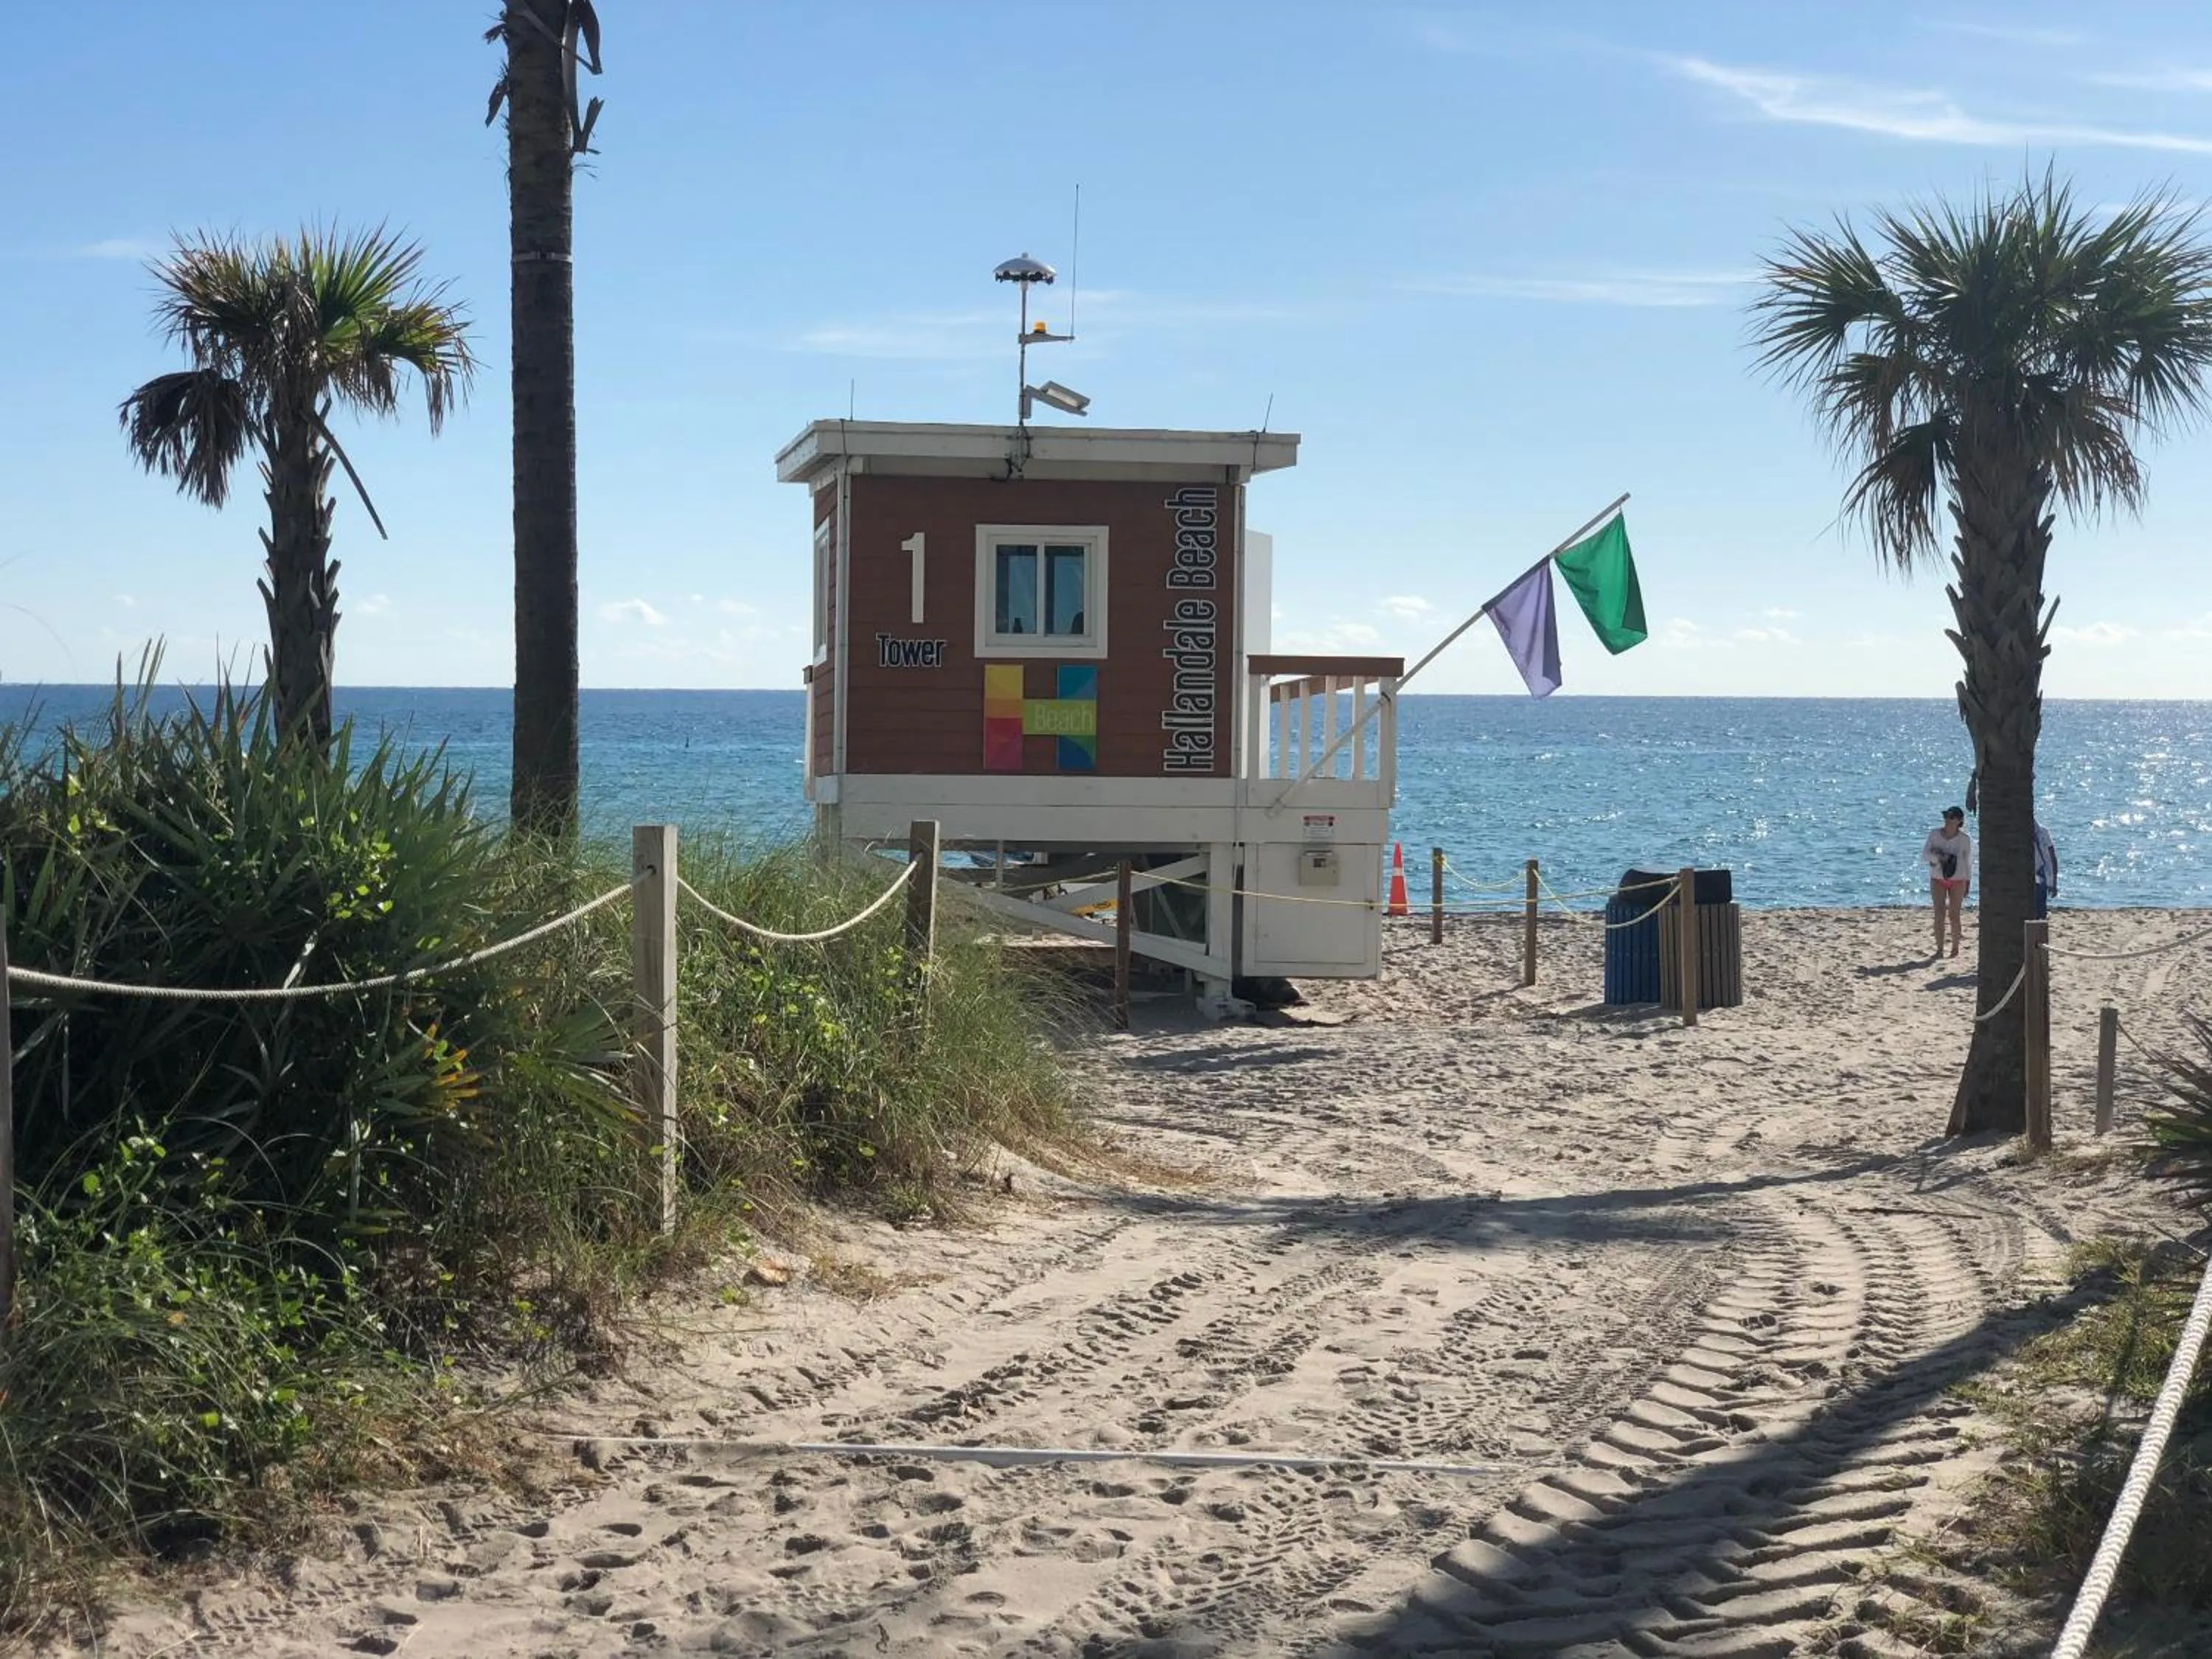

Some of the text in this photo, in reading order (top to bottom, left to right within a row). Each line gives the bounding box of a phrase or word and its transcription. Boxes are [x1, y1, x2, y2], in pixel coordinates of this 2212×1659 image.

[901, 532, 925, 624] 1
[875, 632, 947, 667] Tower
[1161, 487, 1217, 771] Hallandale Beach
[1034, 703, 1094, 731] Beach
